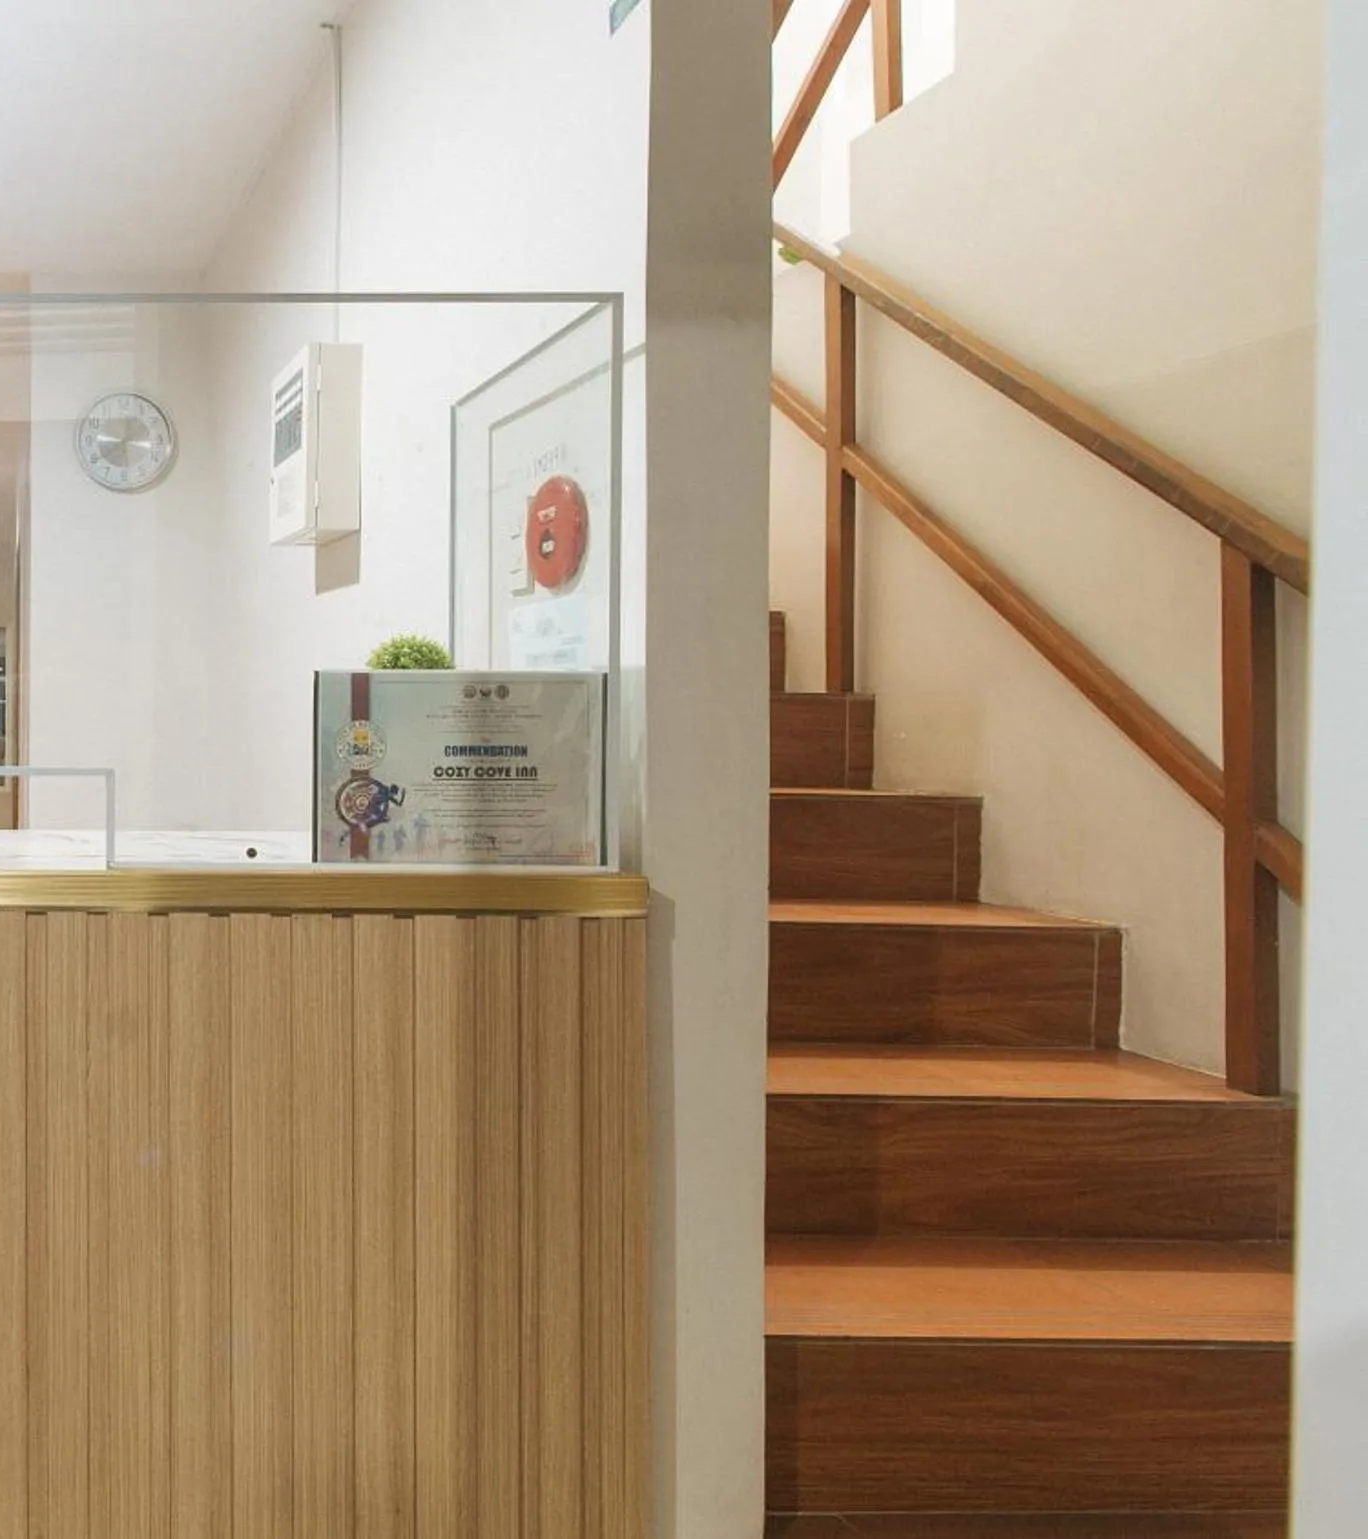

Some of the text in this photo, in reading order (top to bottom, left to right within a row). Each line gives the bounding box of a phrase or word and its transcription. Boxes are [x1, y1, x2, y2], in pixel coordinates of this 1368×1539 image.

[88, 416, 100, 429] 10
[102, 466, 112, 479] 7
[444, 744, 528, 758] COMMENDATION
[433, 765, 472, 778] COZY
[473, 765, 512, 778] COVE
